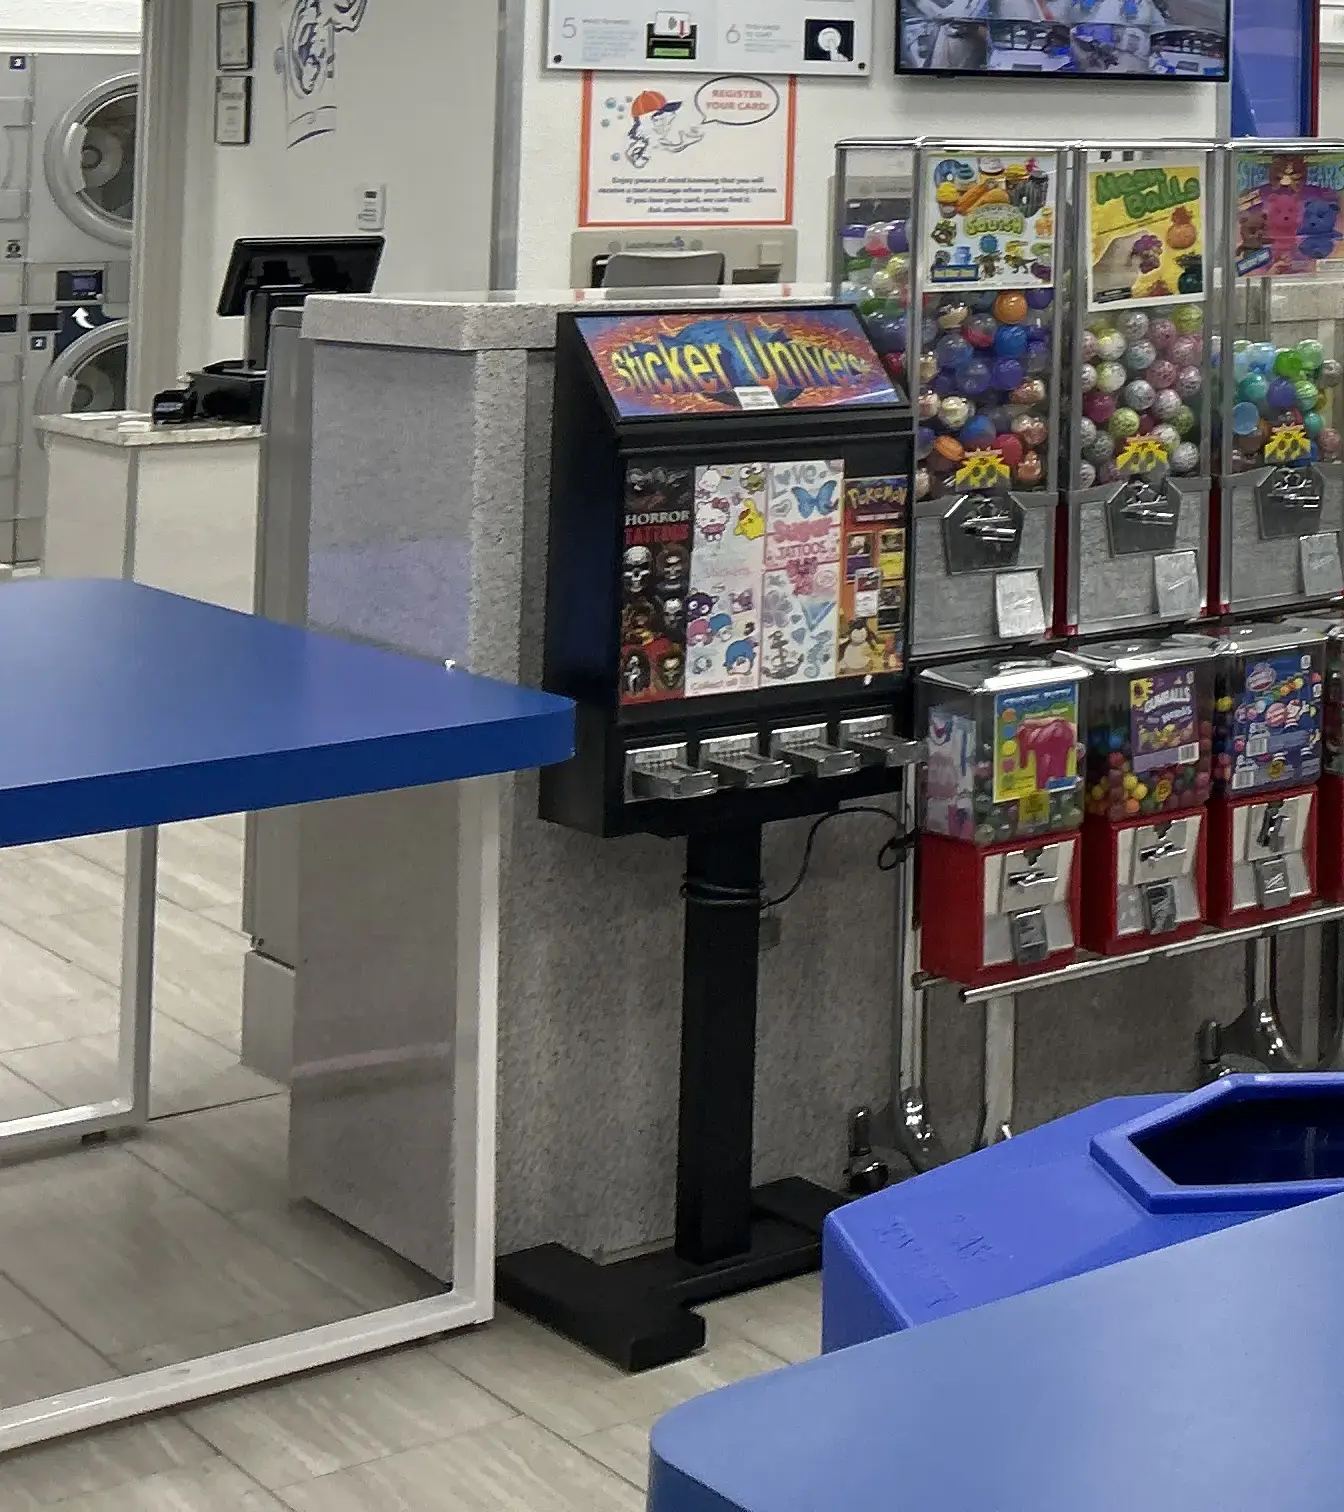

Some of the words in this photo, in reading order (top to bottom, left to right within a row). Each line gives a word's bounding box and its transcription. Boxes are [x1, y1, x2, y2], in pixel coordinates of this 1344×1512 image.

[562, 17, 577, 38] 5
[726, 23, 740, 44] 6
[712, 90, 762, 98] REGISTER
[610, 339, 732, 390] Sticker
[624, 510, 690, 526] HORROR
